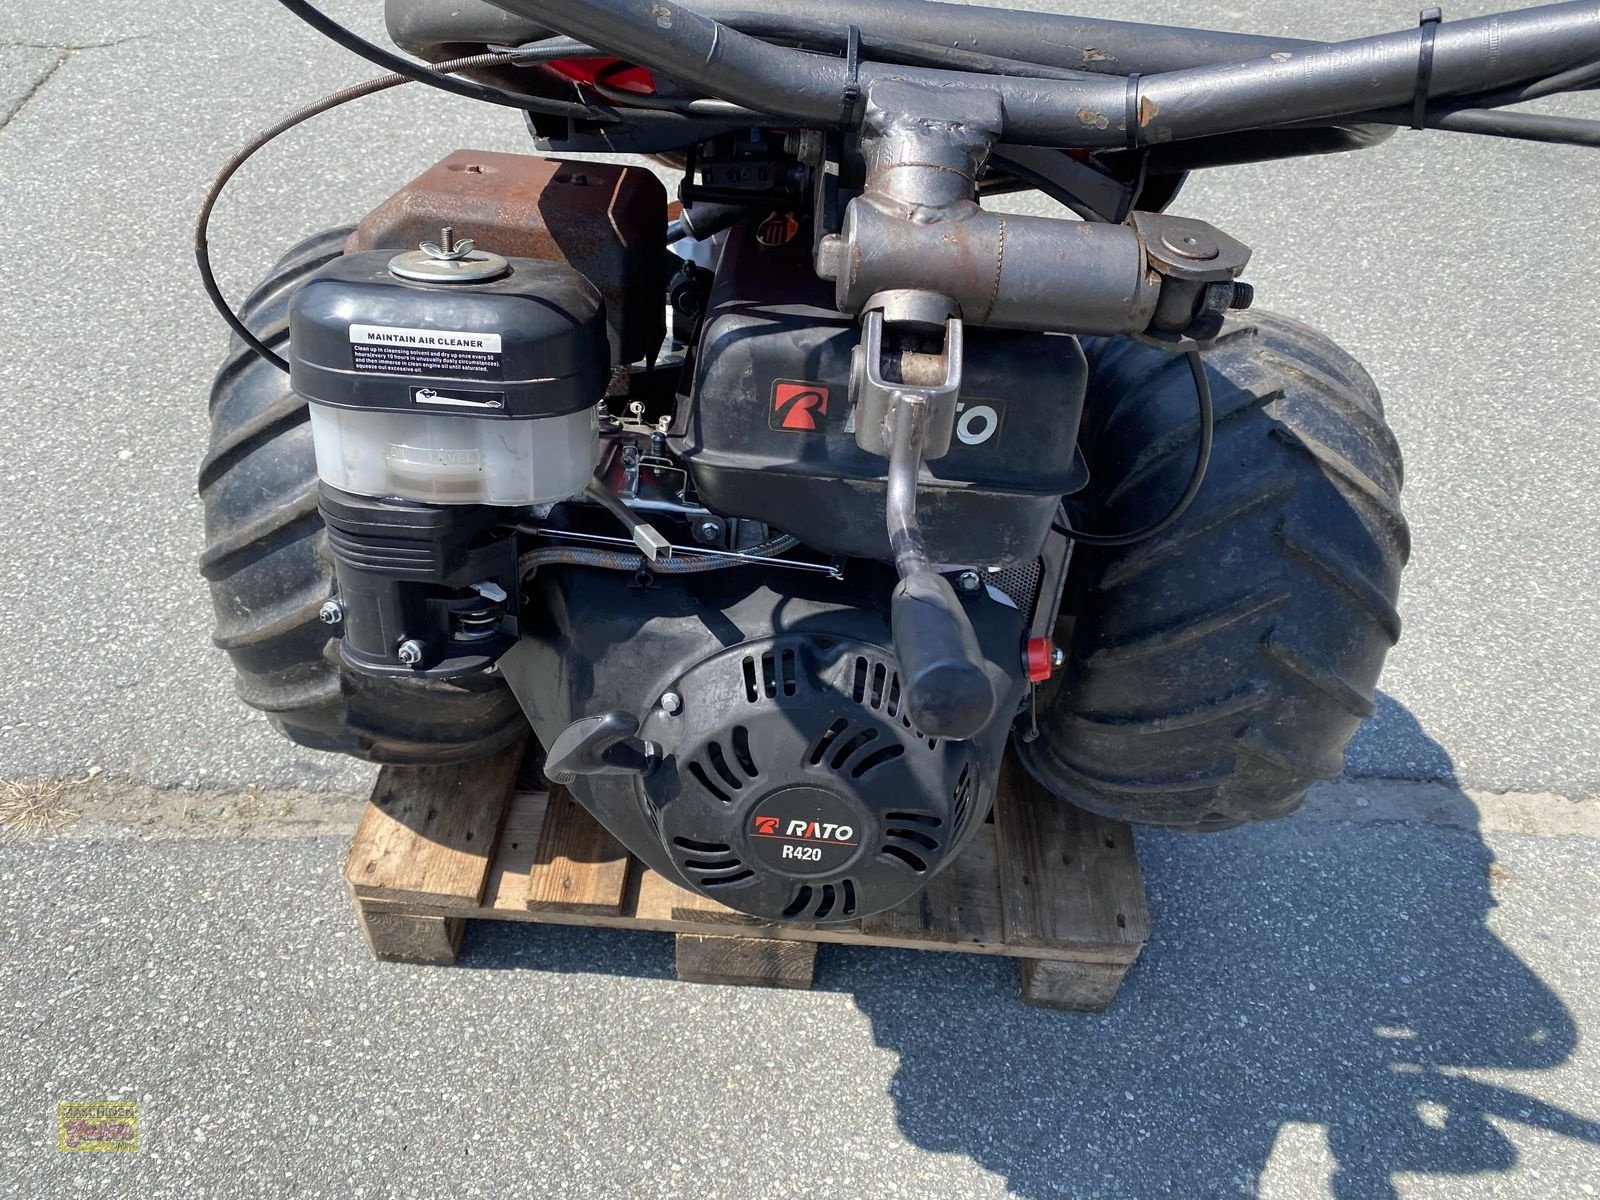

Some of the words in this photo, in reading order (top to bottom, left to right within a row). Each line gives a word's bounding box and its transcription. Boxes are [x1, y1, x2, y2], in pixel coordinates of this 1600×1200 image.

[368, 332, 416, 343] MAINTAIN
[418, 336, 435, 345] AIR
[437, 338, 483, 348] CLEANER
[786, 820, 854, 841] RATO
[782, 844, 822, 861] R420
